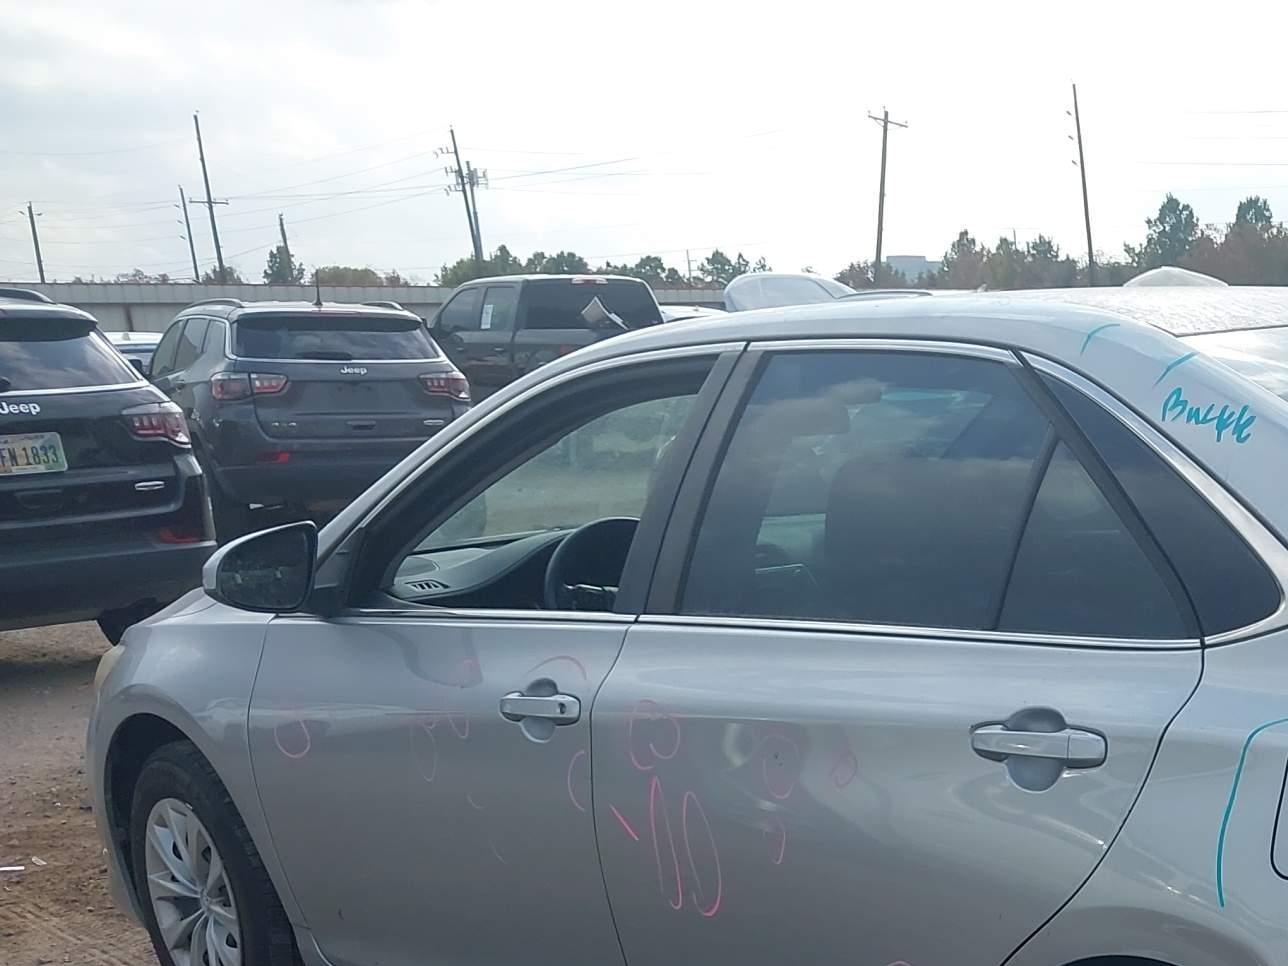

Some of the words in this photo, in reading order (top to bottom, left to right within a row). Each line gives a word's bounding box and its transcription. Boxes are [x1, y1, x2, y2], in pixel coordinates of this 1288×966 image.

[339, 366, 368, 376] Jeep
[0, 401, 41, 415] Jeep
[22, 444, 59, 467] 1833
